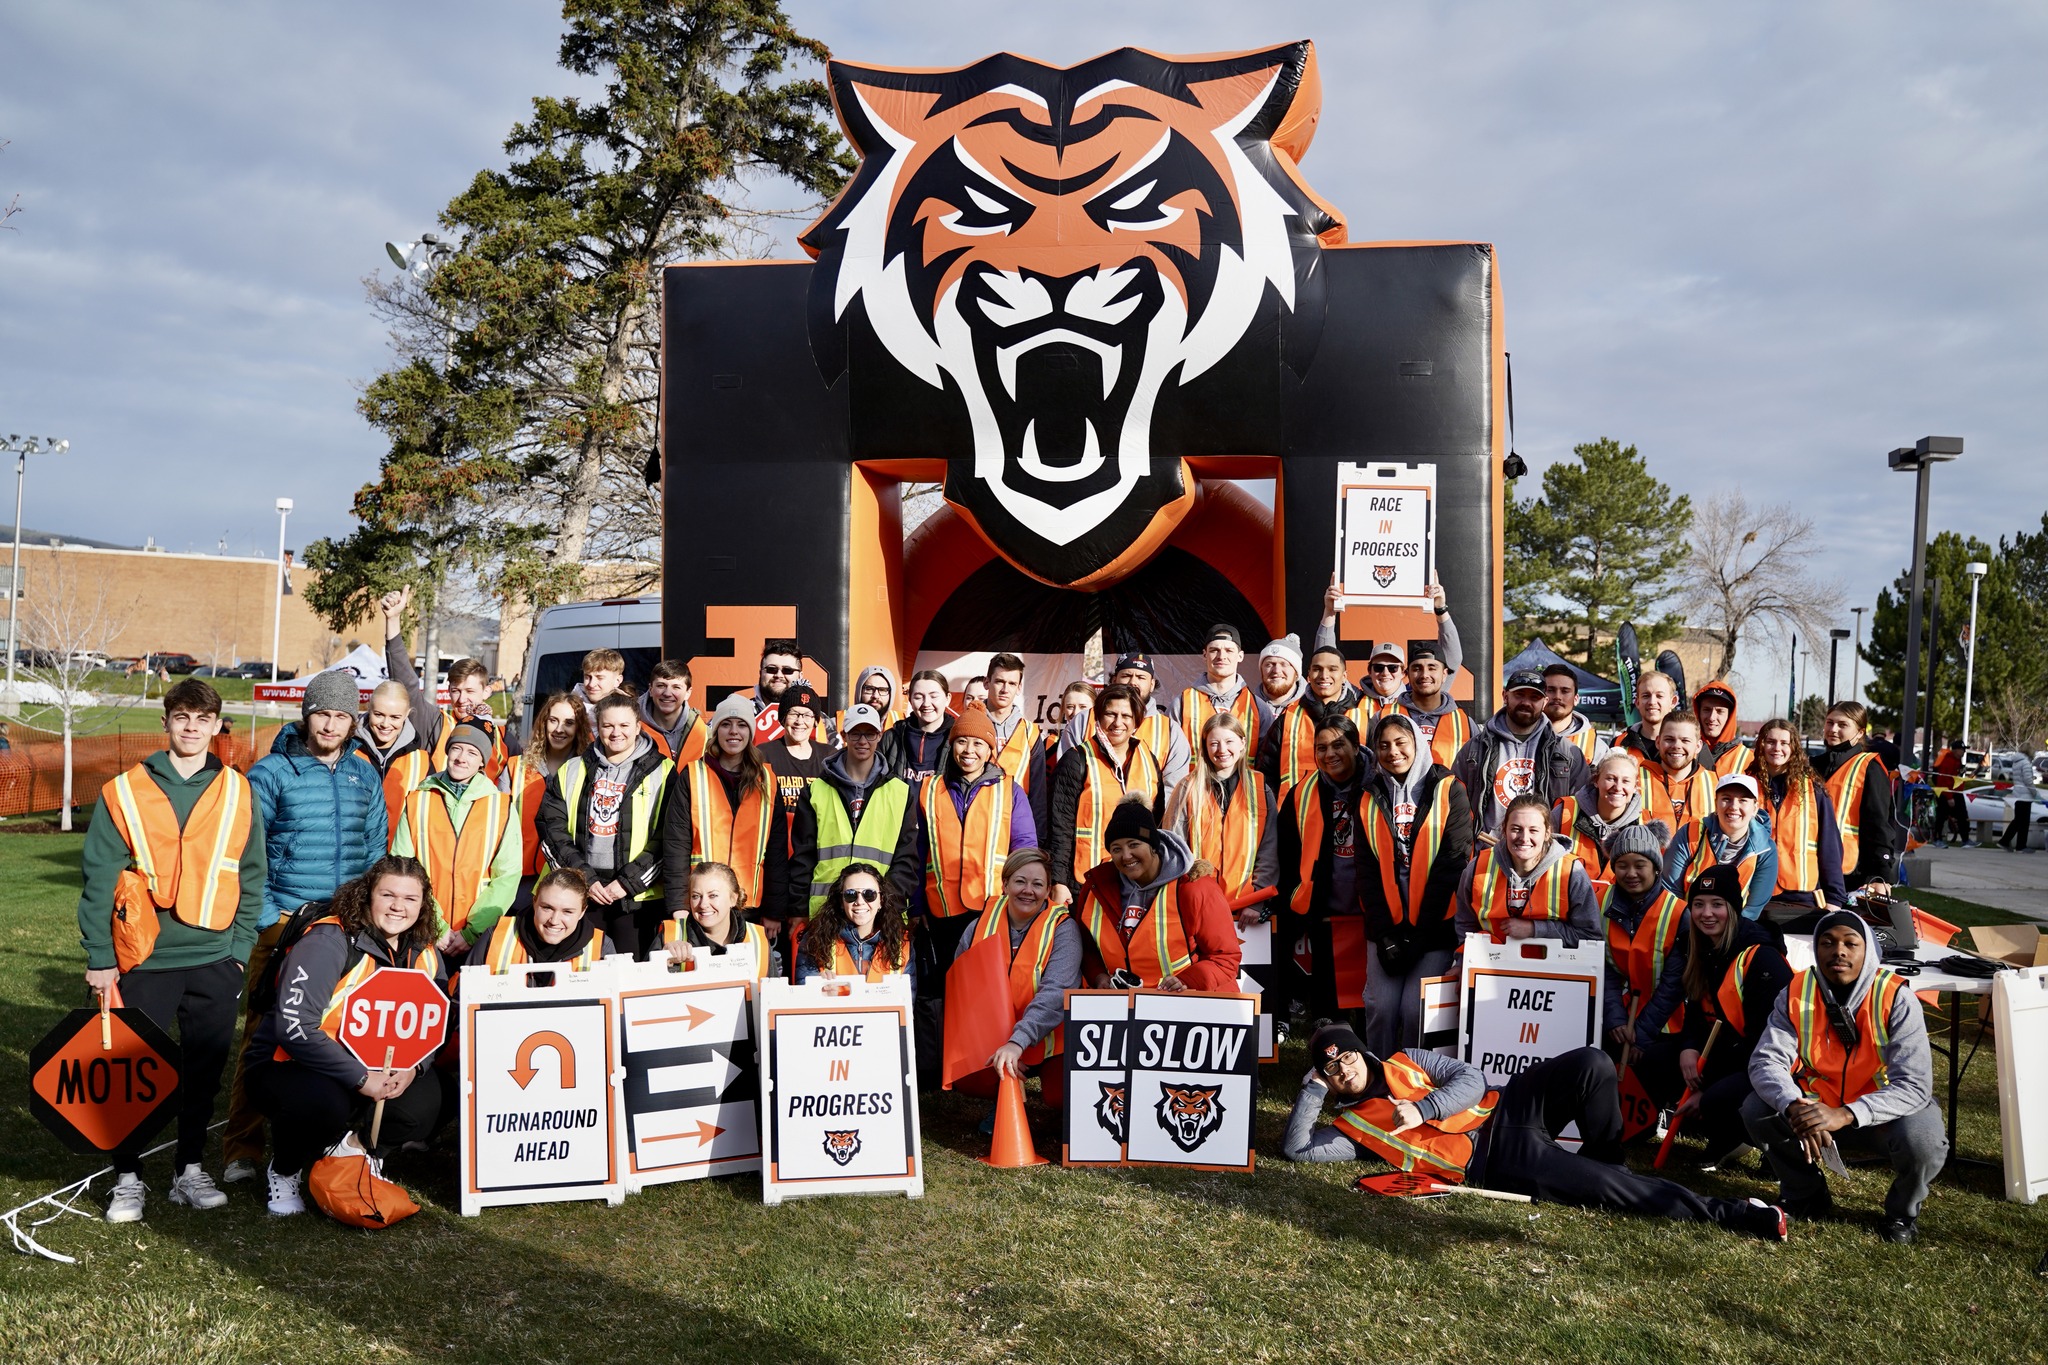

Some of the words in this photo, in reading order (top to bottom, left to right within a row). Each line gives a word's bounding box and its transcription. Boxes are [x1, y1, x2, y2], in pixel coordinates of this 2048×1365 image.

[1370, 497, 1403, 511] RACE
[1379, 520, 1393, 534] IN
[1352, 541, 1419, 557] PROGRESS
[1625, 656, 1634, 672] TRI
[283, 965, 309, 1041] ARIAT
[1507, 988, 1556, 1012] RACE
[349, 998, 441, 1040] STOP
[813, 1025, 864, 1047] RACE
[1076, 1023, 1128, 1067] SL
[1519, 1022, 1540, 1044] IN
[1138, 1023, 1247, 1071] SLOW
[829, 1059, 850, 1081] IN
[1481, 1052, 1553, 1076] PROG
[56, 1056, 158, 1104] SLOW
[788, 1092, 893, 1118] PROGRESS
[486, 1108, 598, 1133] TURNAROUND
[514, 1140, 570, 1162] AHEAD
